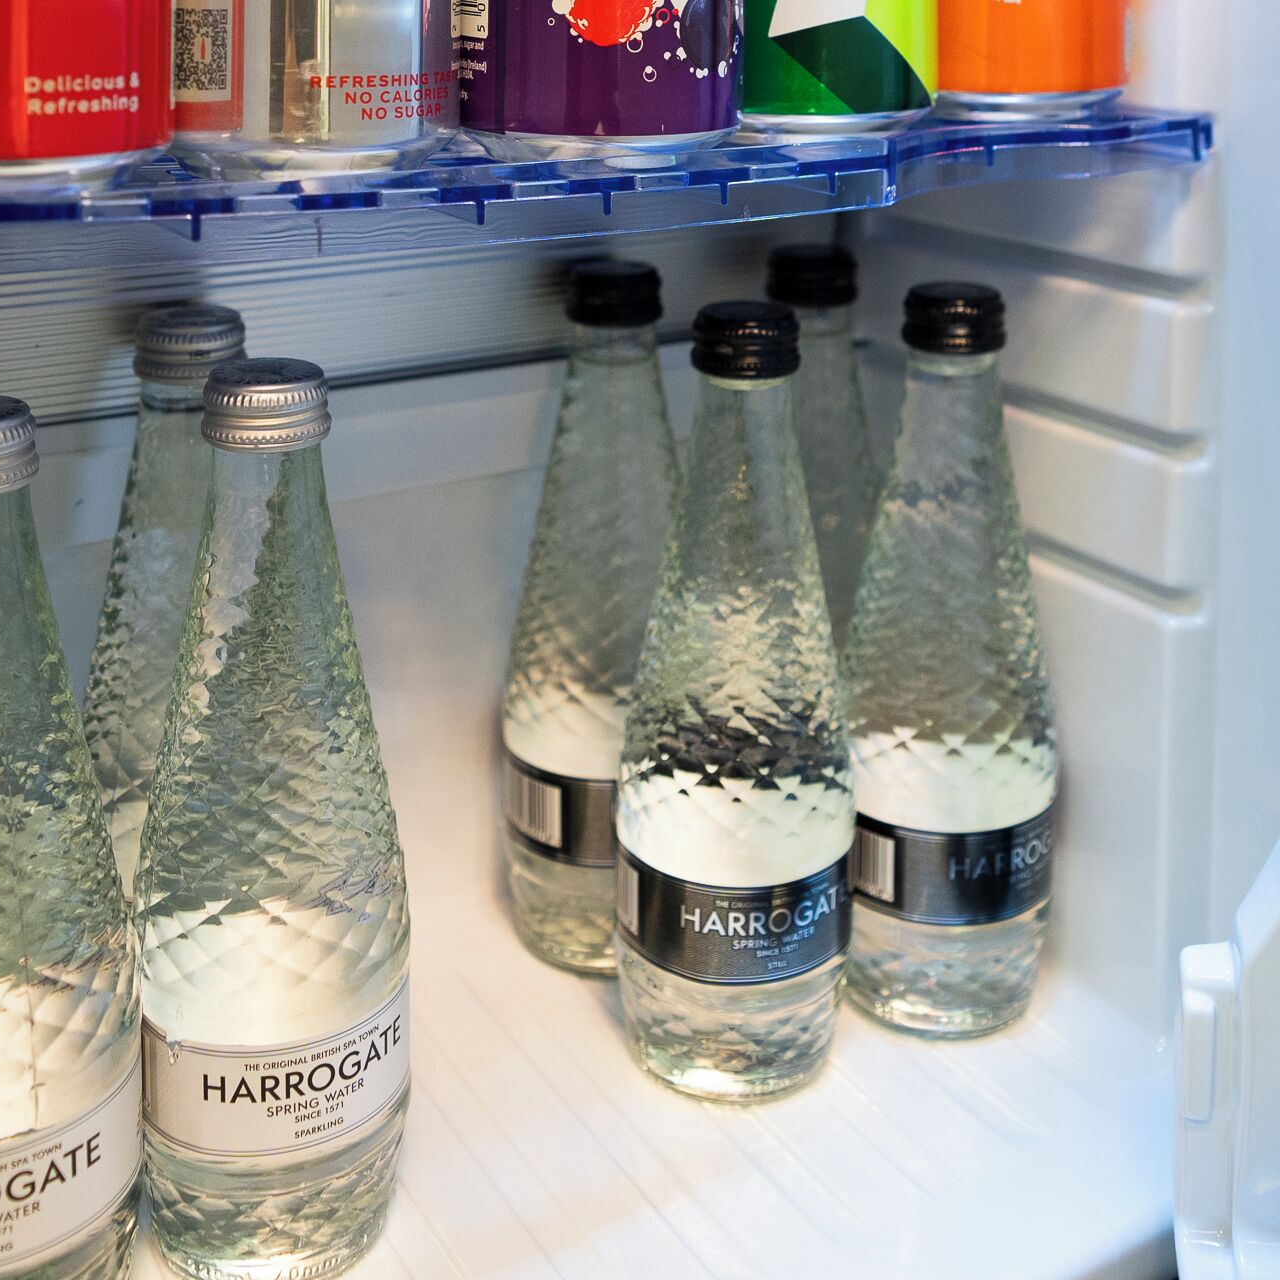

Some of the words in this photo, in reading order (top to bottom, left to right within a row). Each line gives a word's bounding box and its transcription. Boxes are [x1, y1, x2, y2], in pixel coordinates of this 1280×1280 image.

[23, 74, 125, 93] Delicious
[129, 71, 140, 88] &
[309, 72, 429, 89] REFRESHING
[26, 93, 140, 115] Refreshing
[344, 91, 372, 104] NO
[379, 87, 449, 103] CALORIES
[361, 107, 387, 120] NO
[394, 103, 442, 119] SUGAR
[732, 936, 778, 950] SPRING
[203, 1014, 401, 1104] HARROGATE
[244, 1063, 260, 1072] THE
[263, 1056, 308, 1071] ORIGINAL
[310, 1045, 341, 1062] BRITISH
[343, 1040, 357, 1051] SPA
[359, 1024, 380, 1044] TOWN
[266, 1098, 320, 1118] SPRING
[325, 1078, 364, 1103] WATER
[294, 1110, 322, 1123] SINCE
[325, 1101, 345, 1115] 1571
[294, 1117, 344, 1139] SPARKLING
[10, 1157, 29, 1169] SPA
[32, 1142, 63, 1162] TOWN
